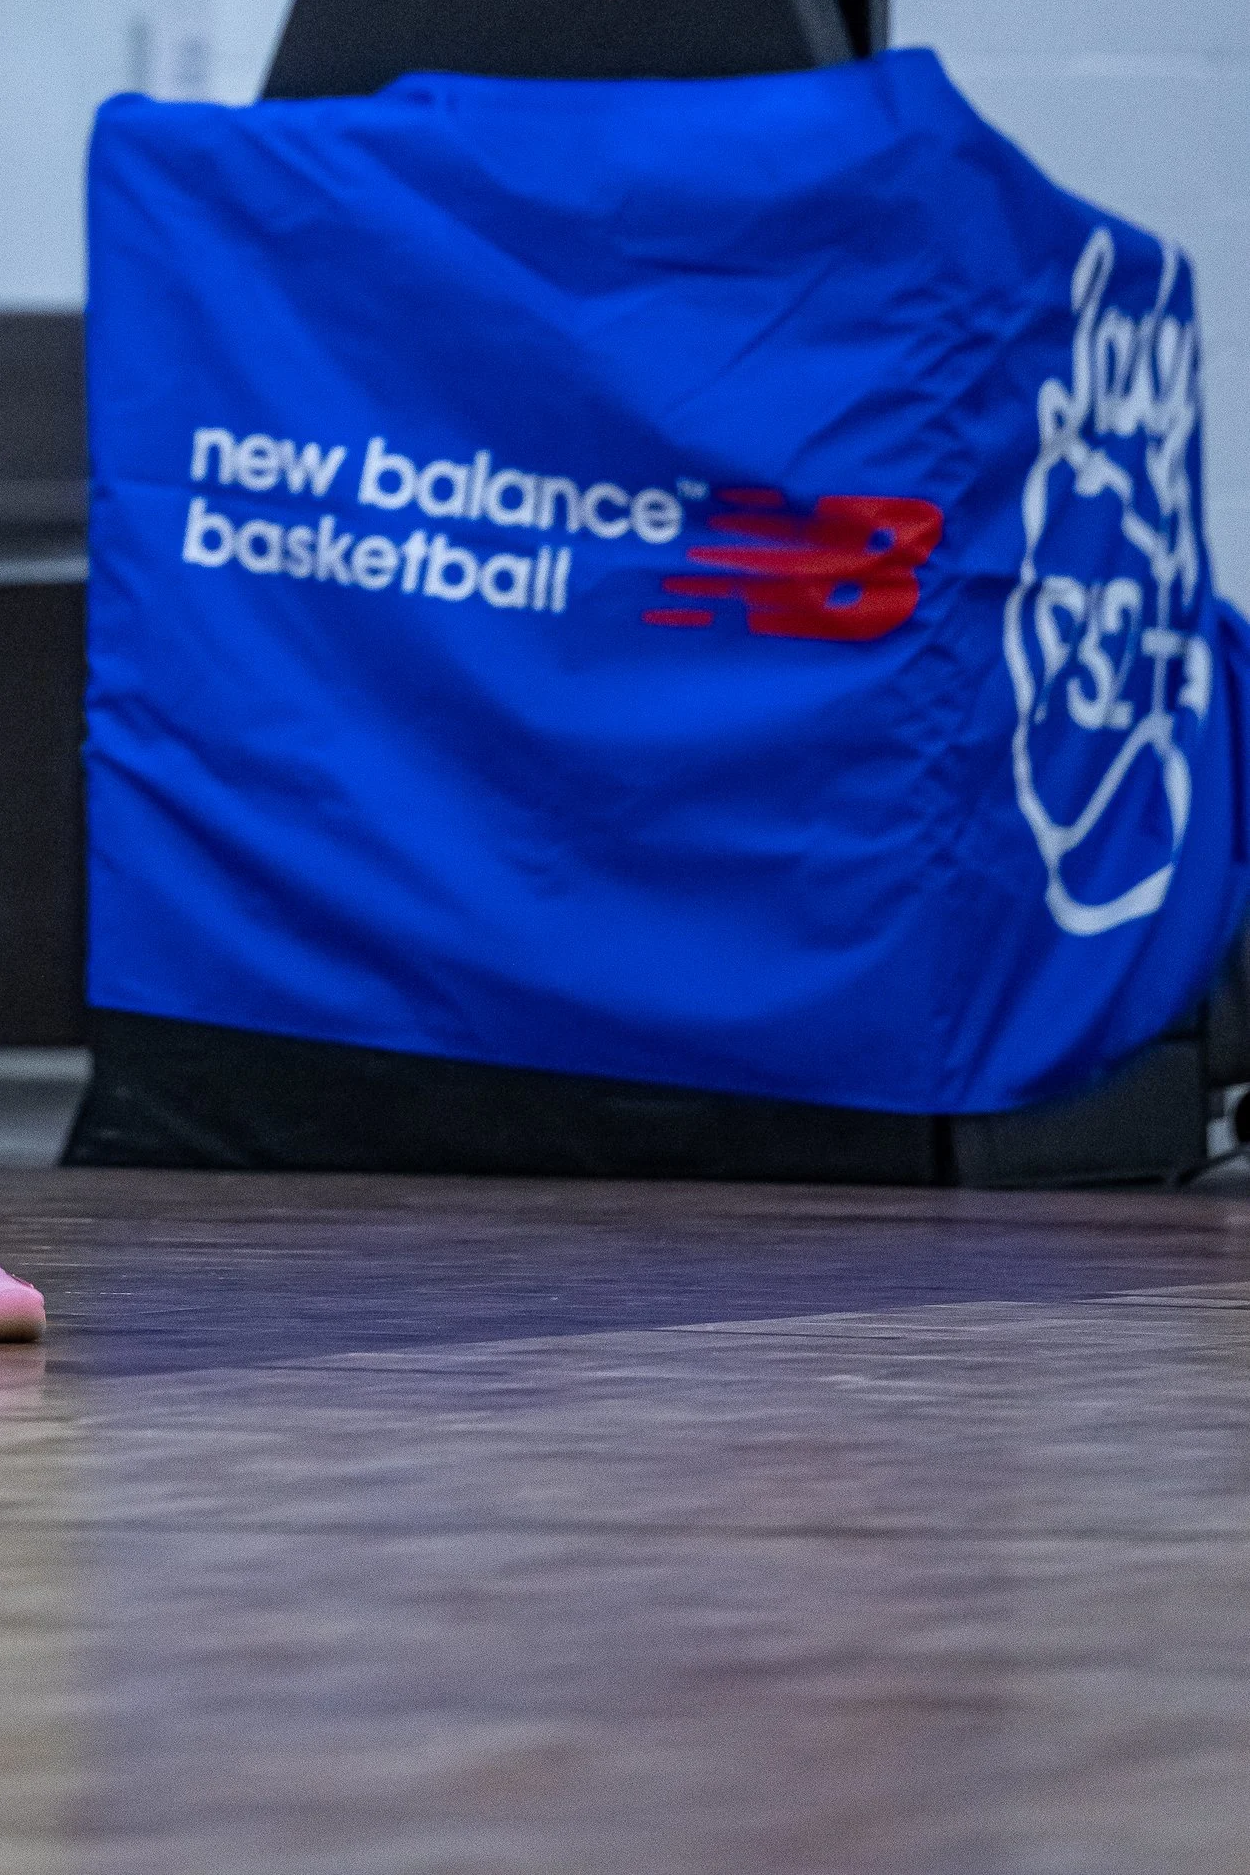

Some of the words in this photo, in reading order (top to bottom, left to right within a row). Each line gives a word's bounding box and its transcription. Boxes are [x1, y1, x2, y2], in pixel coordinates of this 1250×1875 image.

[190, 427, 347, 498] new
[358, 436, 683, 545] balance
[182, 496, 572, 615] basketball
[1034, 575, 1143, 730] P32
